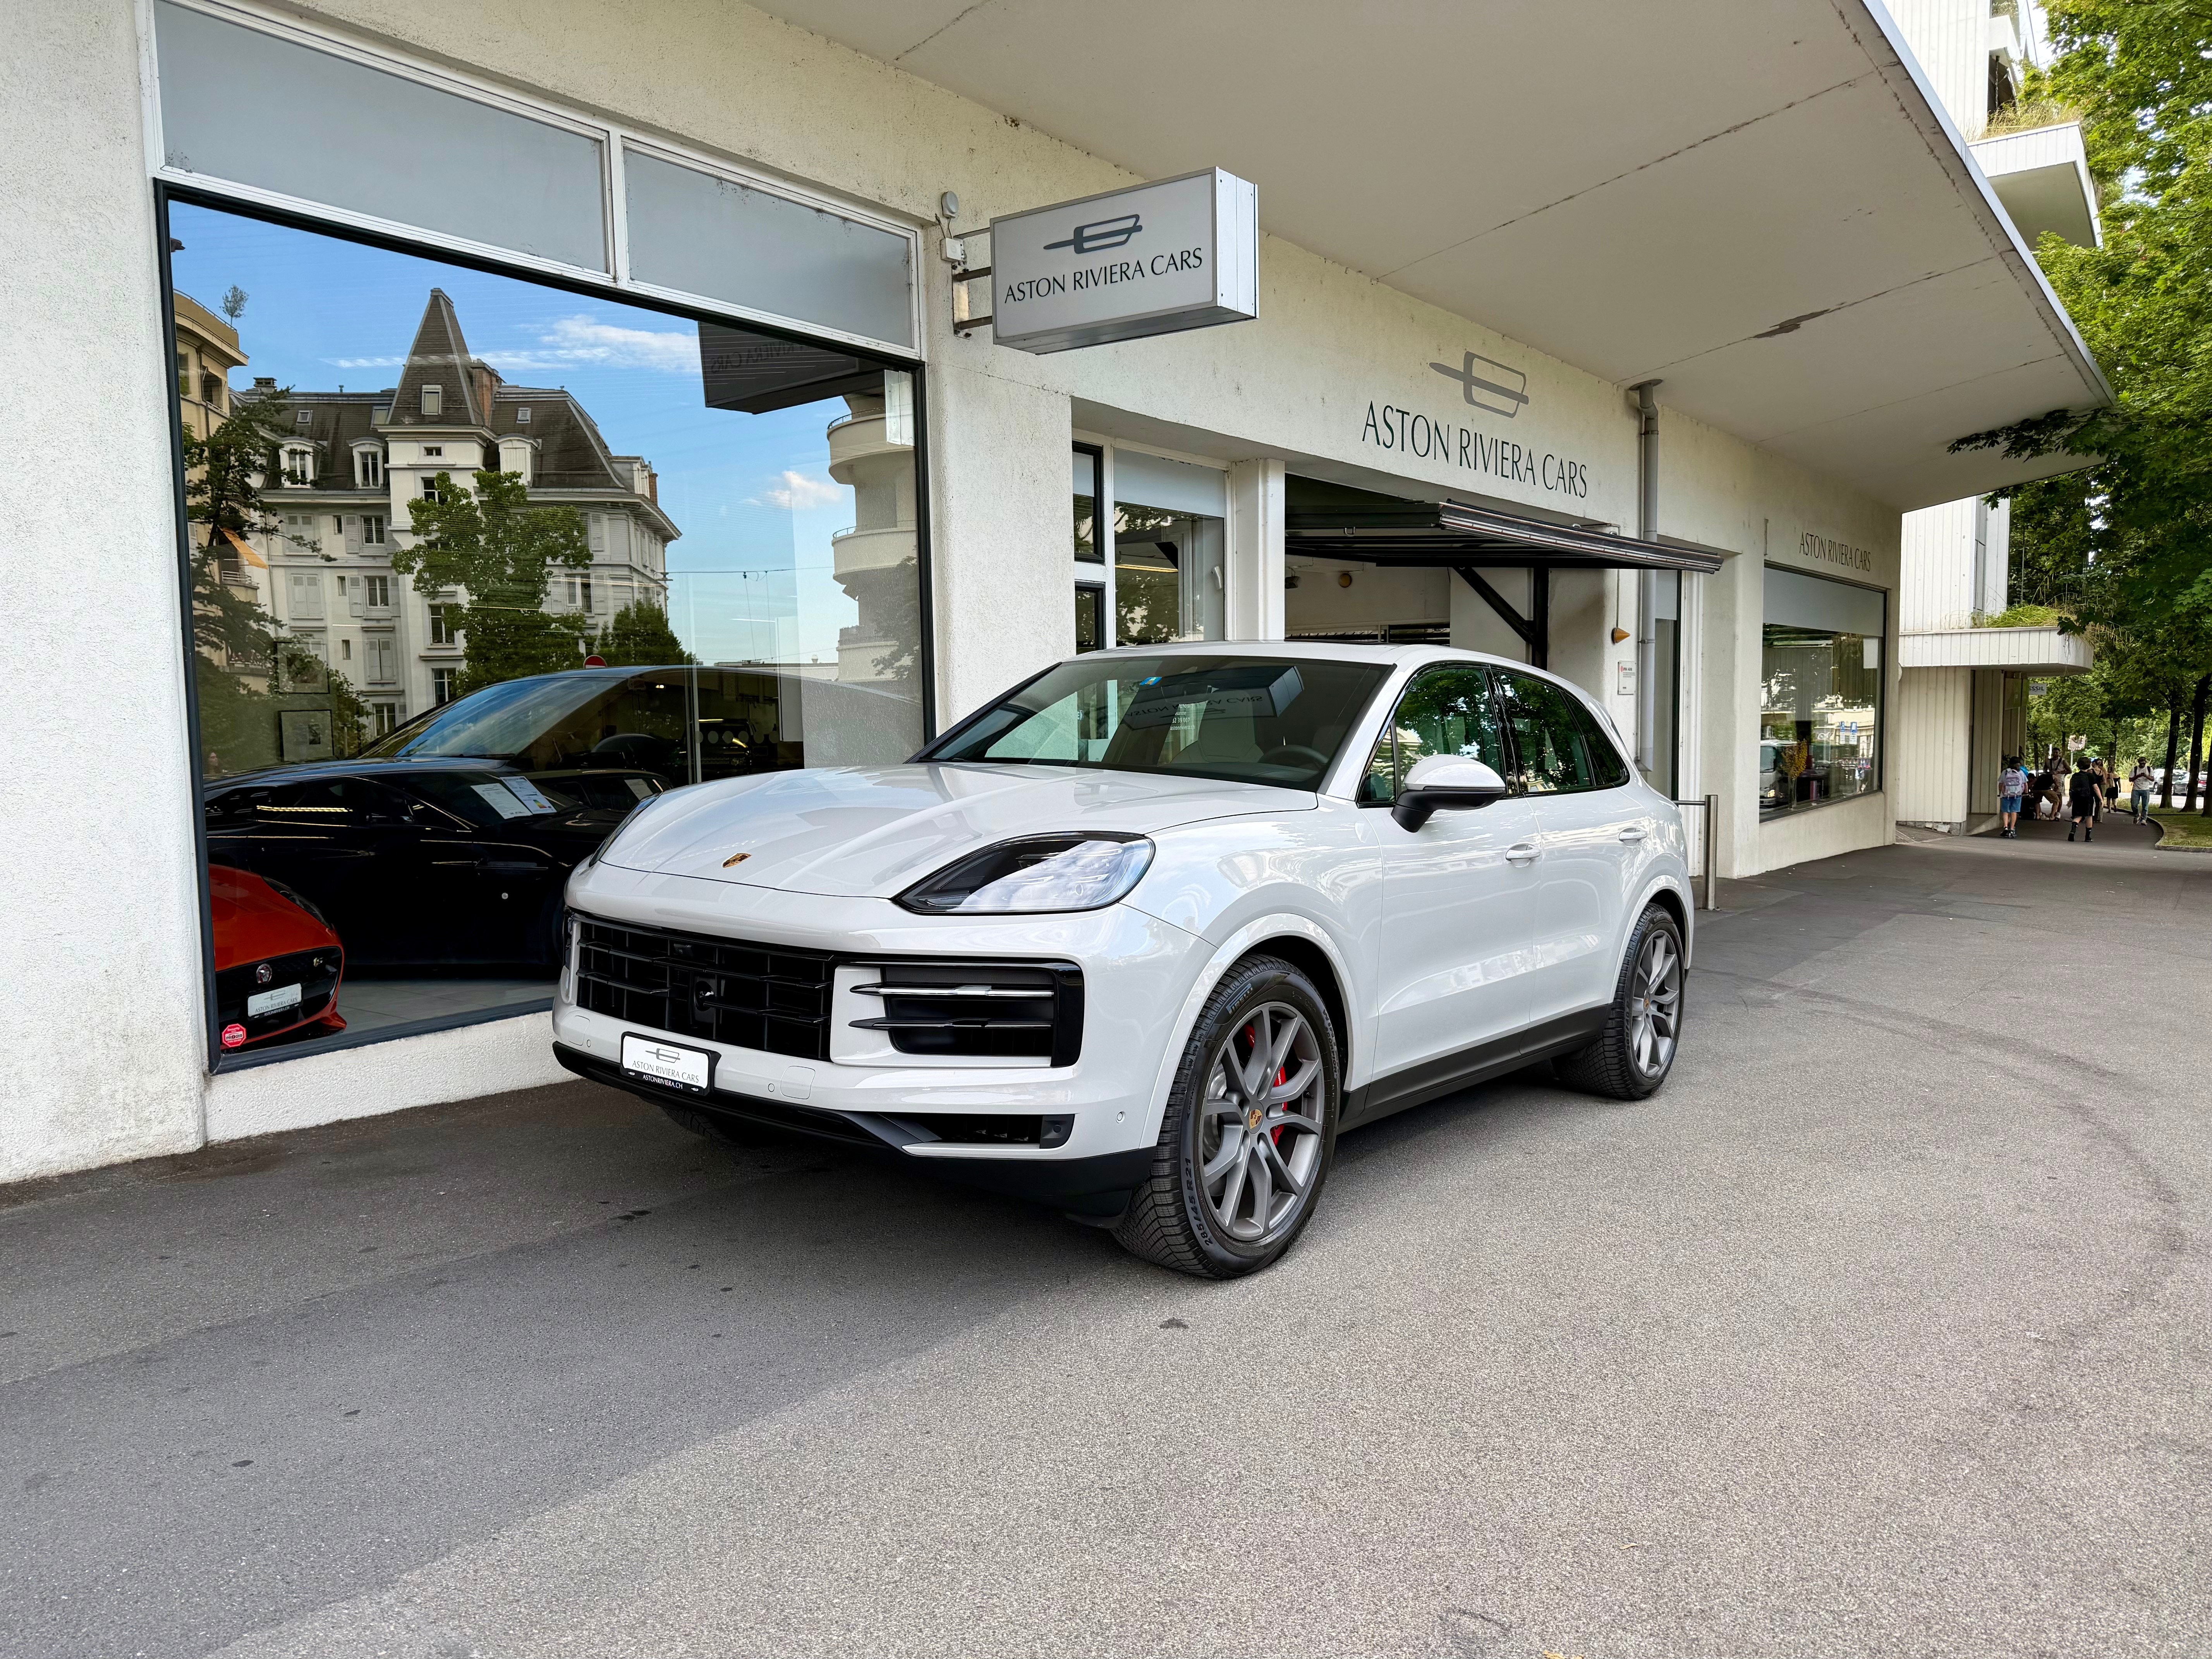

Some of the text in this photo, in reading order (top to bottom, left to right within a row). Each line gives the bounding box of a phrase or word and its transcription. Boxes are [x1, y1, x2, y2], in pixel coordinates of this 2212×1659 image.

[1005, 248, 1203, 304] ASTON RIVIERA CARS
[1362, 400, 1587, 498] ASTON RIVIERA CARS
[1799, 531, 1871, 572] ASTON RIVIERA CARS
[632, 1060, 699, 1083] ASTON RIVIERA CARS
[642, 1074, 683, 1089] ASTONRIVIERA.CH
[1185, 1158, 1213, 1246] 285/45 R21
